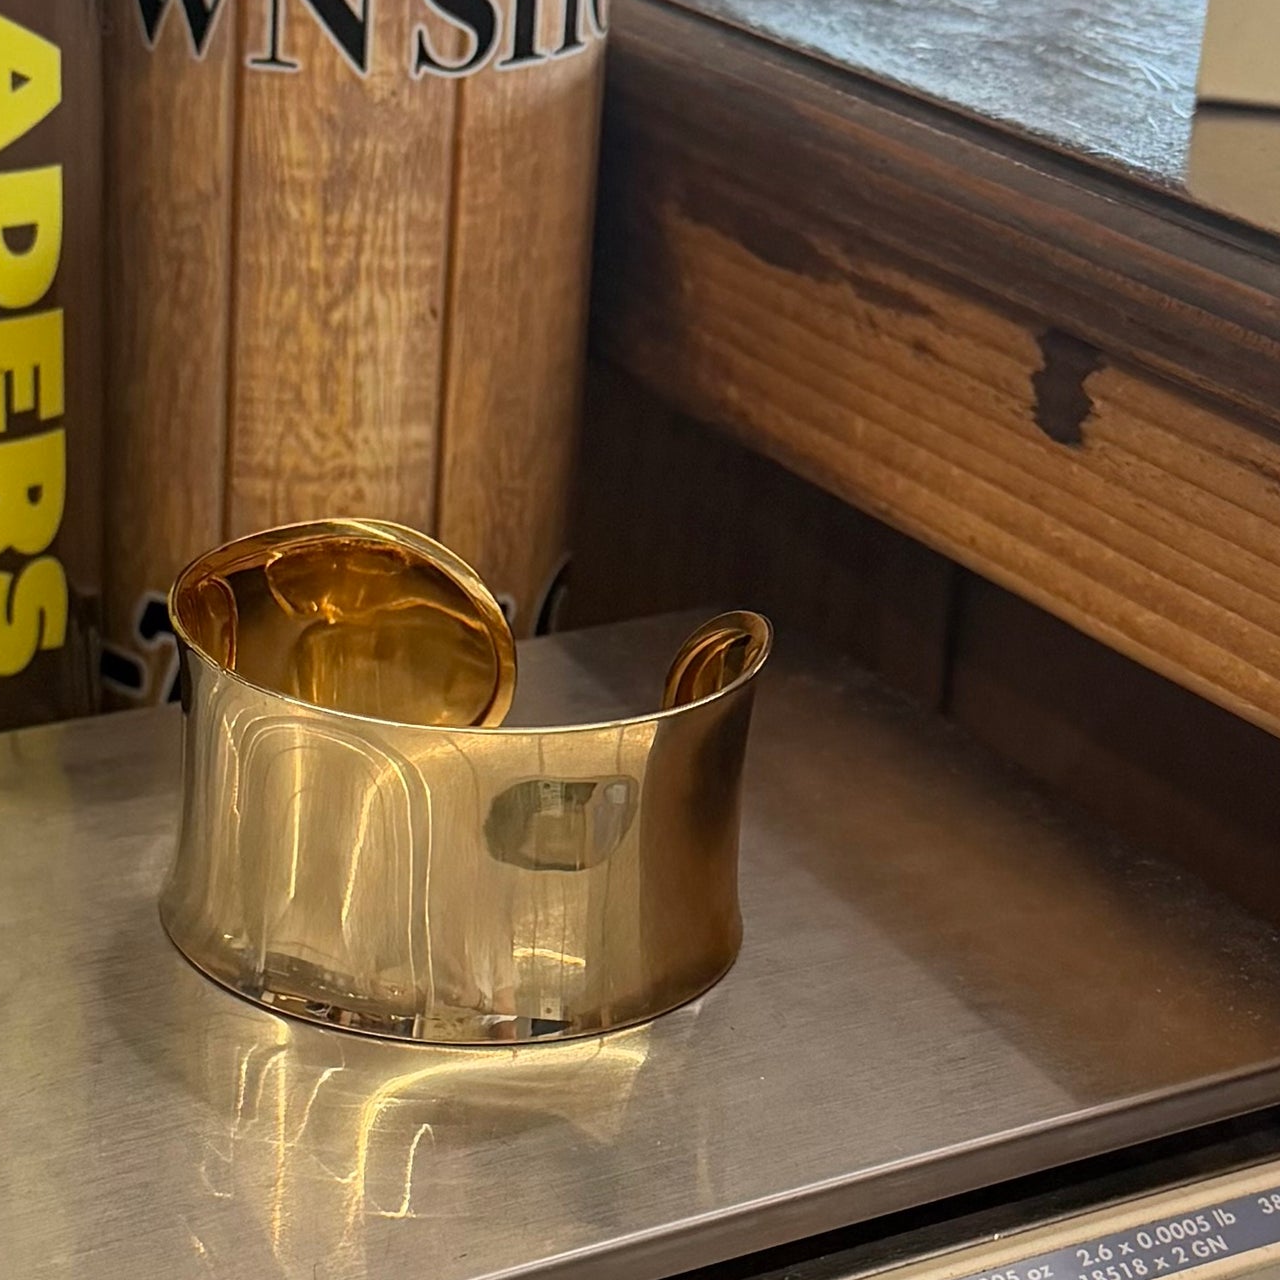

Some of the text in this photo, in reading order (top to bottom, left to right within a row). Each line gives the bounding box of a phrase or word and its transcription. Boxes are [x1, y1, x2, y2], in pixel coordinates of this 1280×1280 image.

[1075, 1243, 1114, 1267] 2.6
[1118, 1241, 1134, 1256] x
[1136, 1215, 1212, 1249] 0.0005
[1214, 1208, 1236, 1228] lb
[1153, 1255, 1170, 1271] x
[1171, 1246, 1189, 1265] 2
[1191, 1234, 1230, 1259] GN
